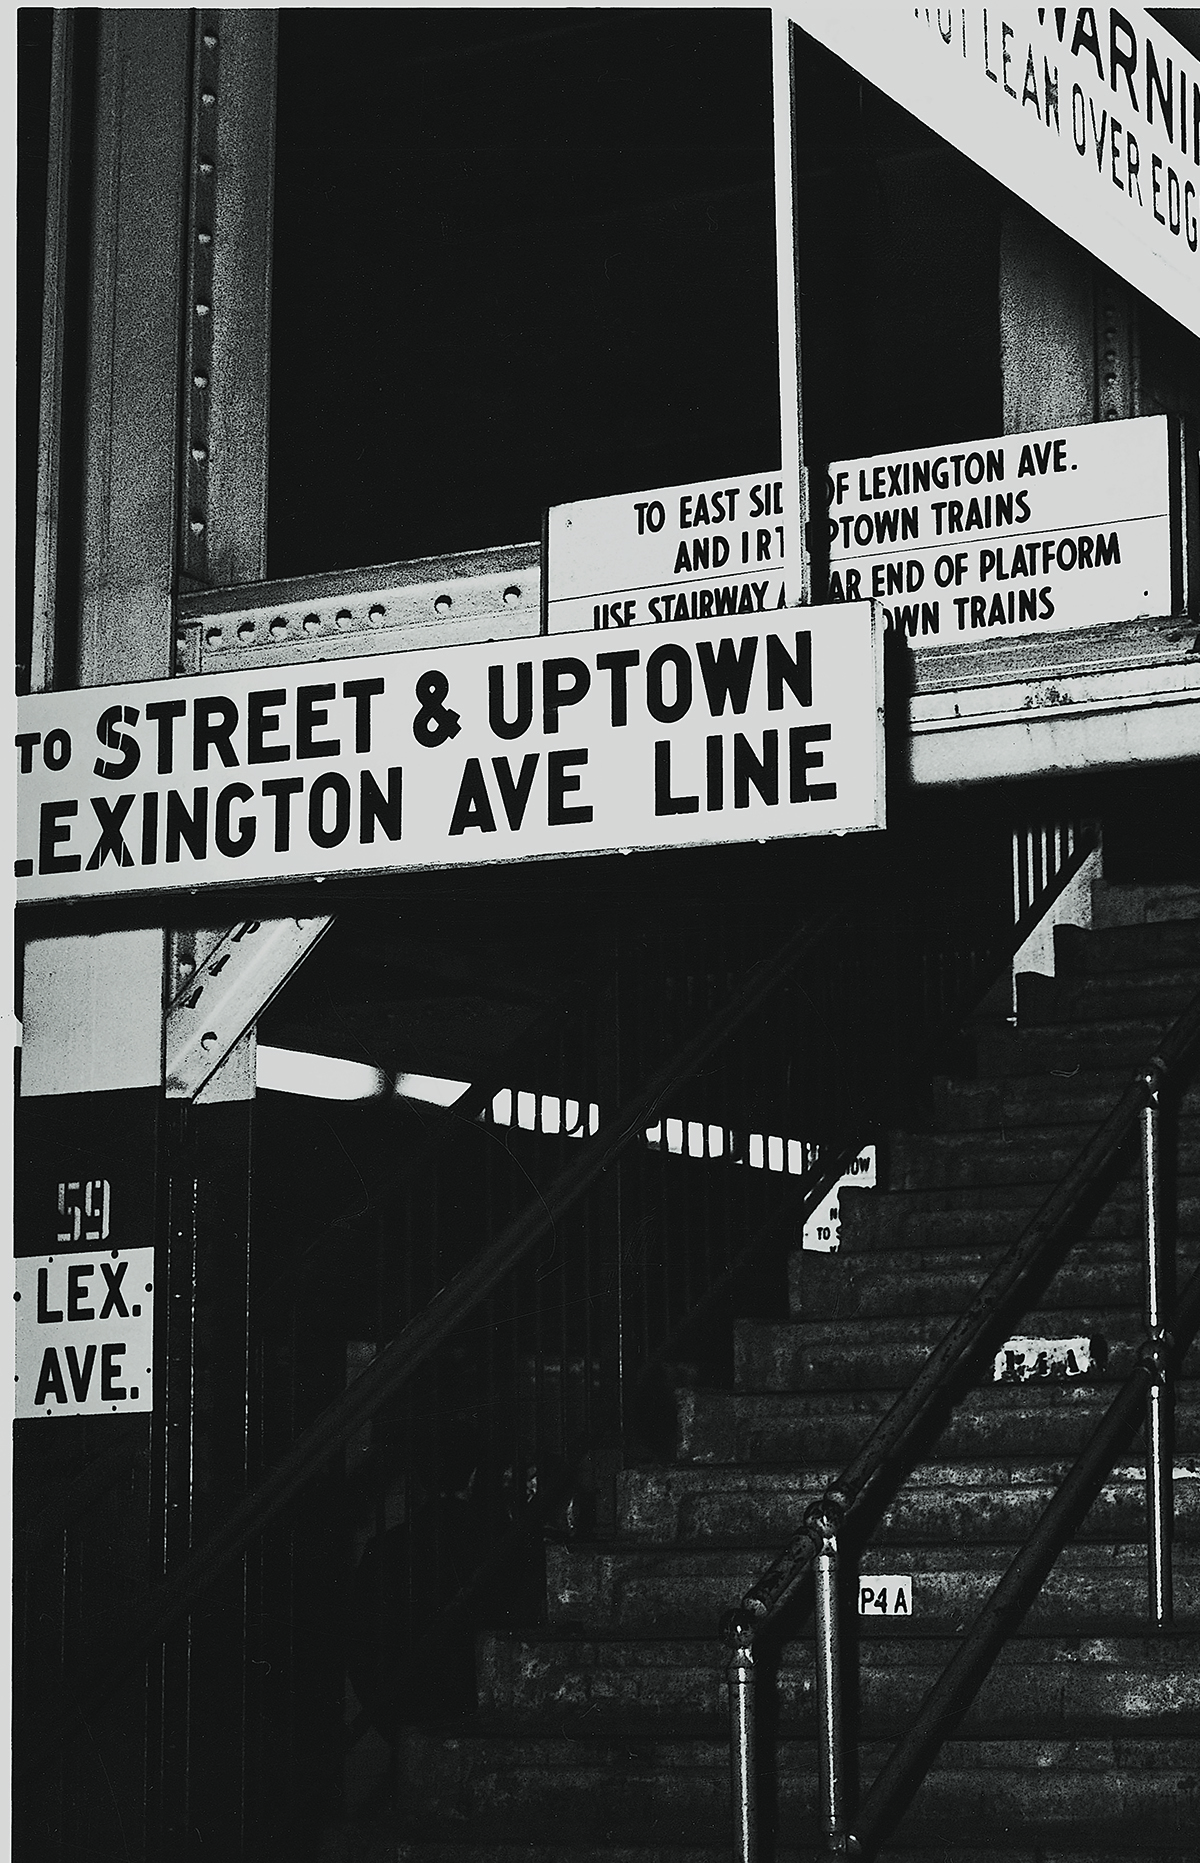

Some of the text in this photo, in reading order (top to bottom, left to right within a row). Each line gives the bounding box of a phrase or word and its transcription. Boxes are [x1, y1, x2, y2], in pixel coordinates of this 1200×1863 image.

[1072, 82, 1142, 206] OVER
[634, 501, 666, 536] TO
[679, 487, 741, 530] EAST
[859, 448, 1005, 502] LEXINGTON
[1018, 440, 1078, 479] AVE.
[673, 530, 730, 574] AND
[806, 505, 919, 551] PTOWN
[931, 489, 1031, 536] TRAINS
[593, 600, 636, 630] USE
[648, 580, 769, 622] STAIRWAY
[829, 568, 862, 602] AR
[871, 559, 925, 598] END
[934, 552, 969, 588] OF
[980, 531, 1122, 583] PLATFORM
[882, 586, 1055, 638] OWN TRAINS
[15, 630, 813, 781] TO STREET & UPTOWN
[448, 747, 594, 836] AVE
[654, 723, 838, 817] LINE
[56, 1178, 112, 1242] 59
[36, 1261, 142, 1325] LEX.
[33, 1342, 140, 1406] AVE.
